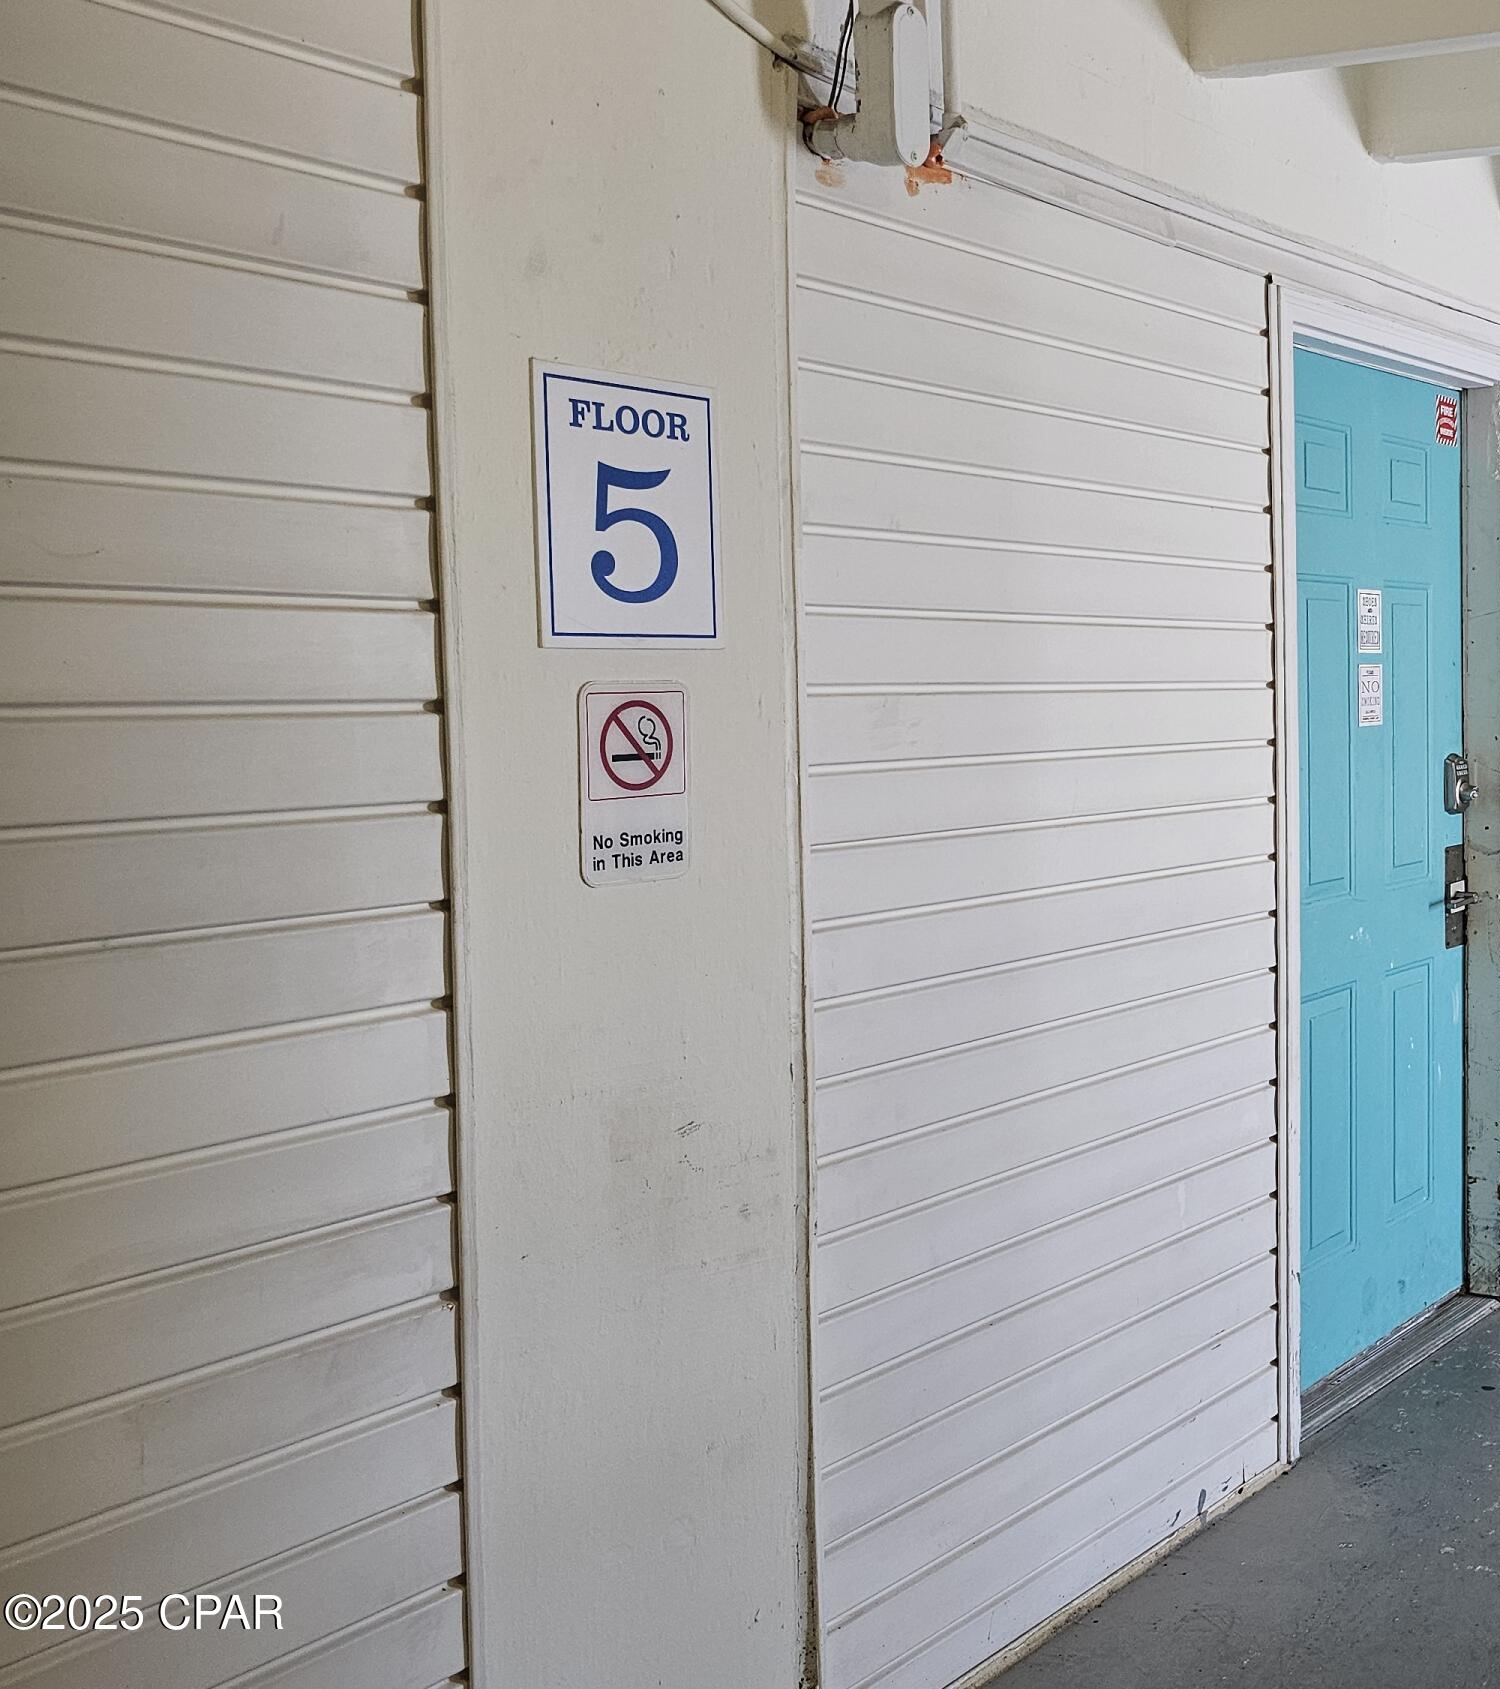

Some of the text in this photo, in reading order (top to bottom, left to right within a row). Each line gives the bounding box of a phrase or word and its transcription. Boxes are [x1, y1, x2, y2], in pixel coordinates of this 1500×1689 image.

[569, 398, 690, 442] FLOOR
[591, 461, 678, 604] 5
[1361, 680, 1380, 694] NO
[593, 828, 684, 850] No Smoking
[593, 847, 684, 871] in This Area
